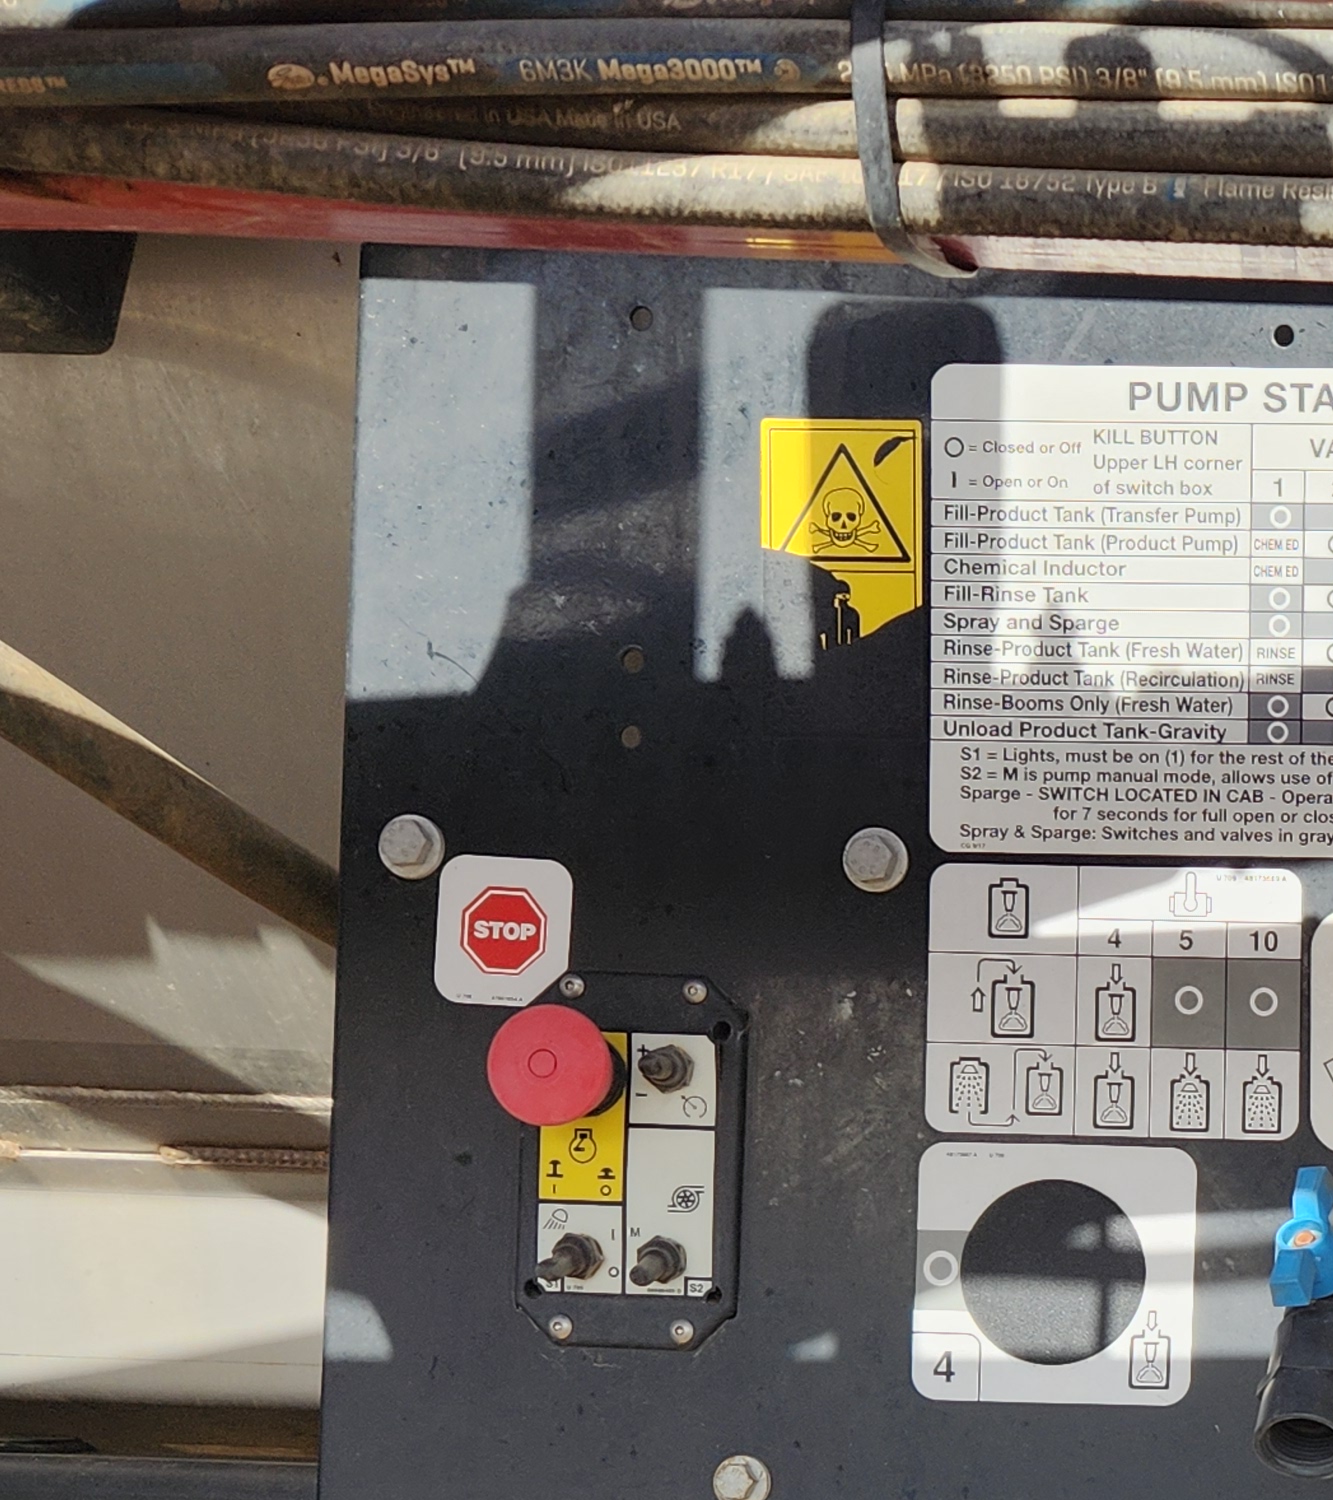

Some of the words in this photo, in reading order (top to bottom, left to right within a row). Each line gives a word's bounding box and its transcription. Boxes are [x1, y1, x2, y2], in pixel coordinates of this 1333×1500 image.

[520, 61, 591, 82] 6M3K
[1129, 381, 1248, 413] PUMP
[1093, 430, 1133, 445] KILL
[1141, 431, 1218, 445] BUTTON
[982, 441, 1034, 454] Closed
[1040, 444, 1055, 454] or
[1060, 442, 1081, 454] Off
[1093, 454, 1148, 473] Upper
[1154, 456, 1177, 470] LH
[1184, 458, 1243, 471] corner
[982, 476, 1022, 490] Open
[1027, 478, 1042, 488] or
[1048, 476, 1068, 489] On
[1093, 480, 1110, 495] of
[1117, 480, 1173, 496] switch
[1180, 481, 1213, 497] box
[1273, 480, 1283, 497] 1
[944, 505, 1048, 522] Fill-Product
[1054, 506, 1094, 523] Tank
[1101, 506, 1179, 526] (Transfer
[1185, 507, 1241, 528] Pump)
[944, 532, 1048, 549] Fill-Product
[1054, 533, 1094, 550] Tank
[1101, 534, 1176, 553] (Product
[1182, 535, 1238, 555] Pump)
[1254, 539, 1283, 550] CHEM
[1286, 539, 1299, 550] ED
[944, 558, 1036, 576] Chemical
[1044, 560, 1126, 577] Inductor
[944, 586, 1036, 602] Fill-Rinse
[1043, 587, 1089, 603] Tank
[944, 613, 999, 632] Spray
[1006, 614, 1042, 631] and
[1049, 615, 1119, 635] Sparge
[944, 640, 1072, 658] Rinse-Product
[1078, 642, 1119, 659] Tank
[1125, 642, 1180, 661] (Fresh
[1187, 643, 1243, 662] Water)
[1256, 648, 1296, 659] RINSE
[944, 668, 1068, 686] Rinse-Product
[1074, 670, 1114, 687] Tank
[1120, 671, 1245, 691] (Recirculation)
[1256, 673, 1295, 686] RINSE
[944, 694, 1064, 712] Rinse-Booms
[1070, 695, 1108, 715] Only
[1115, 696, 1170, 715] (Fresh
[1176, 697, 1232, 716] Water)
[944, 721, 1012, 737] Unload
[1019, 721, 1096, 739] Product
[1103, 722, 1226, 744] Tank-Gravity
[960, 748, 981, 762] S1
[1003, 748, 1060, 765] Lights,
[1066, 751, 1107, 764] must
[1165, 750, 1185, 767] (1)
[1219, 751, 1245, 766] the
[1251, 752, 1283, 766] rest
[960, 766, 982, 781] S2
[1003, 768, 1018, 781] M
[1043, 771, 1091, 786] pump
[1096, 769, 1158, 783] manual
[1163, 770, 1216, 787] mode,
[1221, 771, 1275, 785] allows
[1281, 774, 1311, 785] use
[960, 786, 1020, 802] Sparge
[1038, 788, 1109, 802] SWITCH
[1114, 789, 1198, 803] LOCATED
[1203, 789, 1220, 803] IN
[1226, 789, 1263, 804] CAB
[1082, 808, 1092, 821] 7
[1097, 807, 1168, 822] seconds
[1202, 807, 1227, 823] full
[1232, 810, 1275, 826] open
[960, 824, 1008, 841] Spray
[1031, 825, 1096, 842] Sparge:
[1101, 826, 1178, 842] Switches
[1184, 828, 1215, 842] and
[1220, 828, 1273, 843] valves
[473, 921, 536, 941] STOP
[1106, 927, 1122, 951] 4
[1179, 928, 1194, 952] 5
[1250, 929, 1278, 953] 10
[630, 1227, 640, 1237] M
[689, 1284, 704, 1293] S2
[932, 1350, 957, 1384] 4
